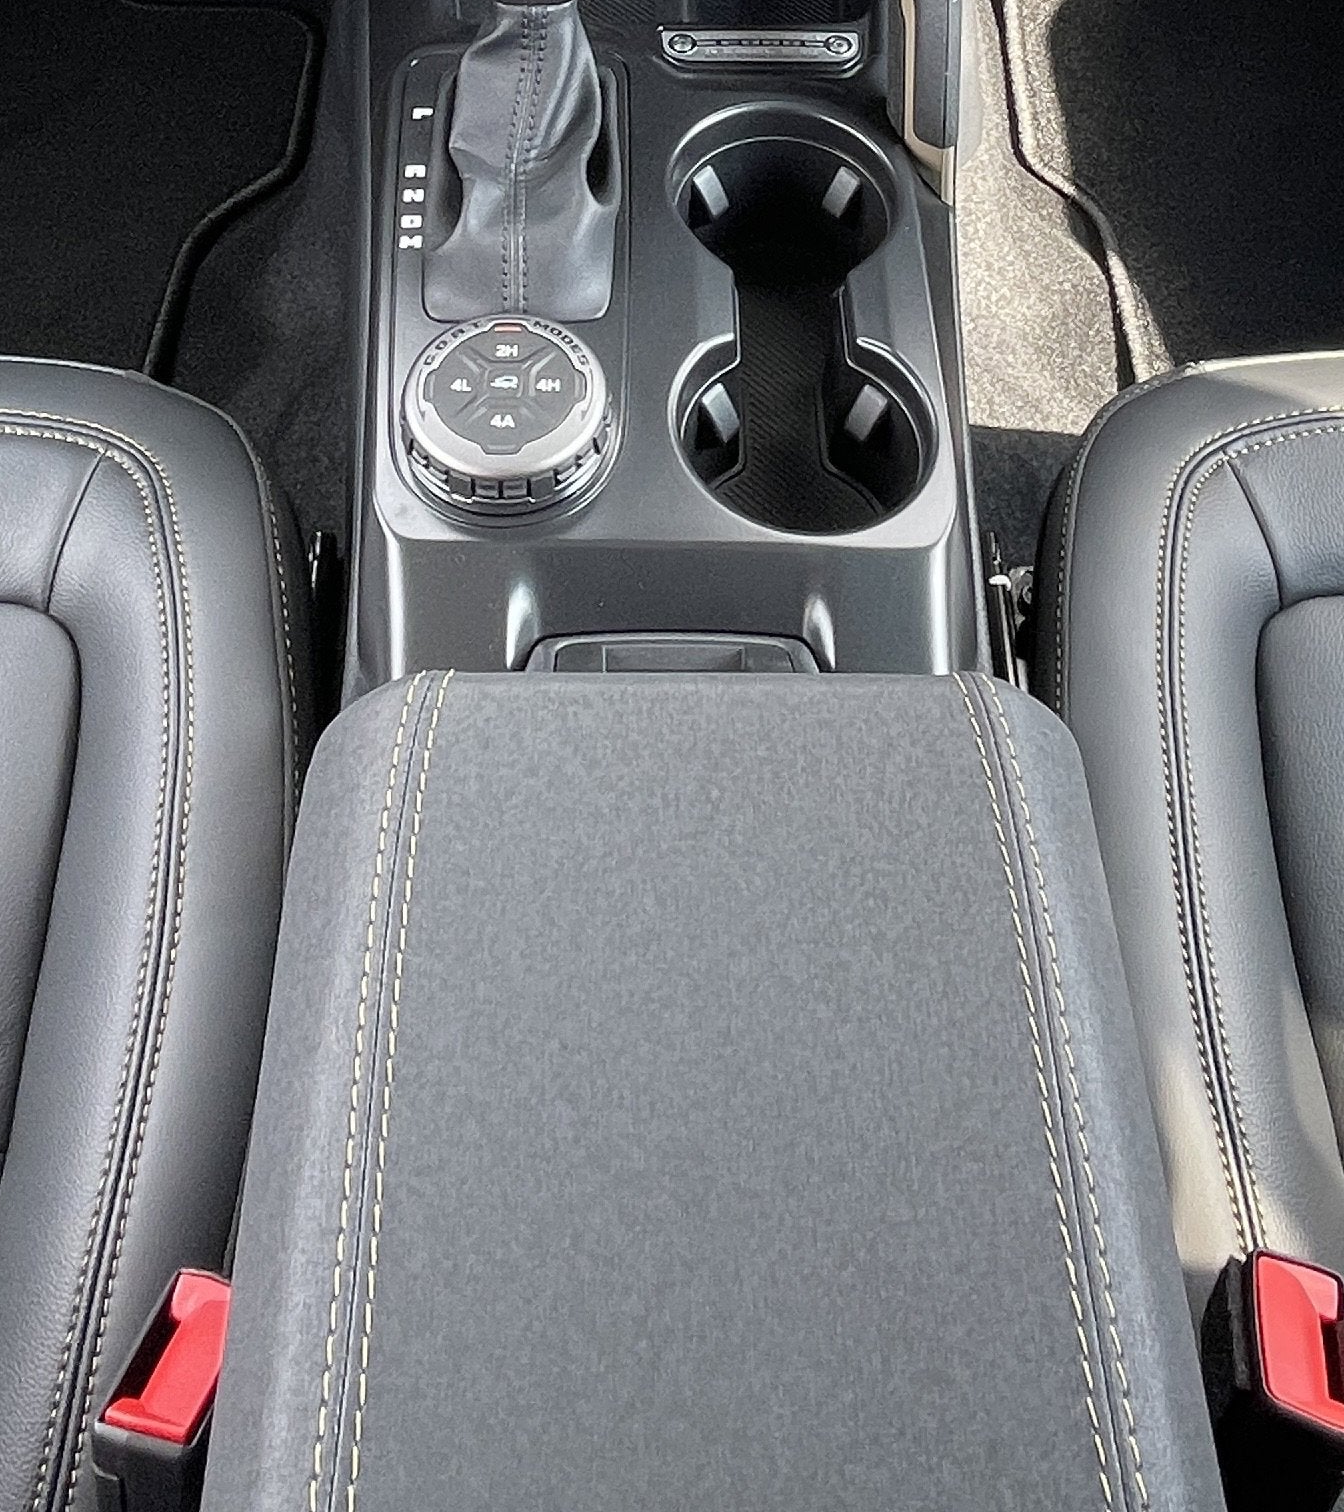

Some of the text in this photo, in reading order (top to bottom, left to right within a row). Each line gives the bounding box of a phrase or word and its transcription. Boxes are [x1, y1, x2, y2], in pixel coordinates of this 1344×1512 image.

[494, 344, 519, 357] 2H
[450, 378, 472, 392] 4L
[536, 378, 561, 392] 4H
[490, 414, 516, 428] 4A
